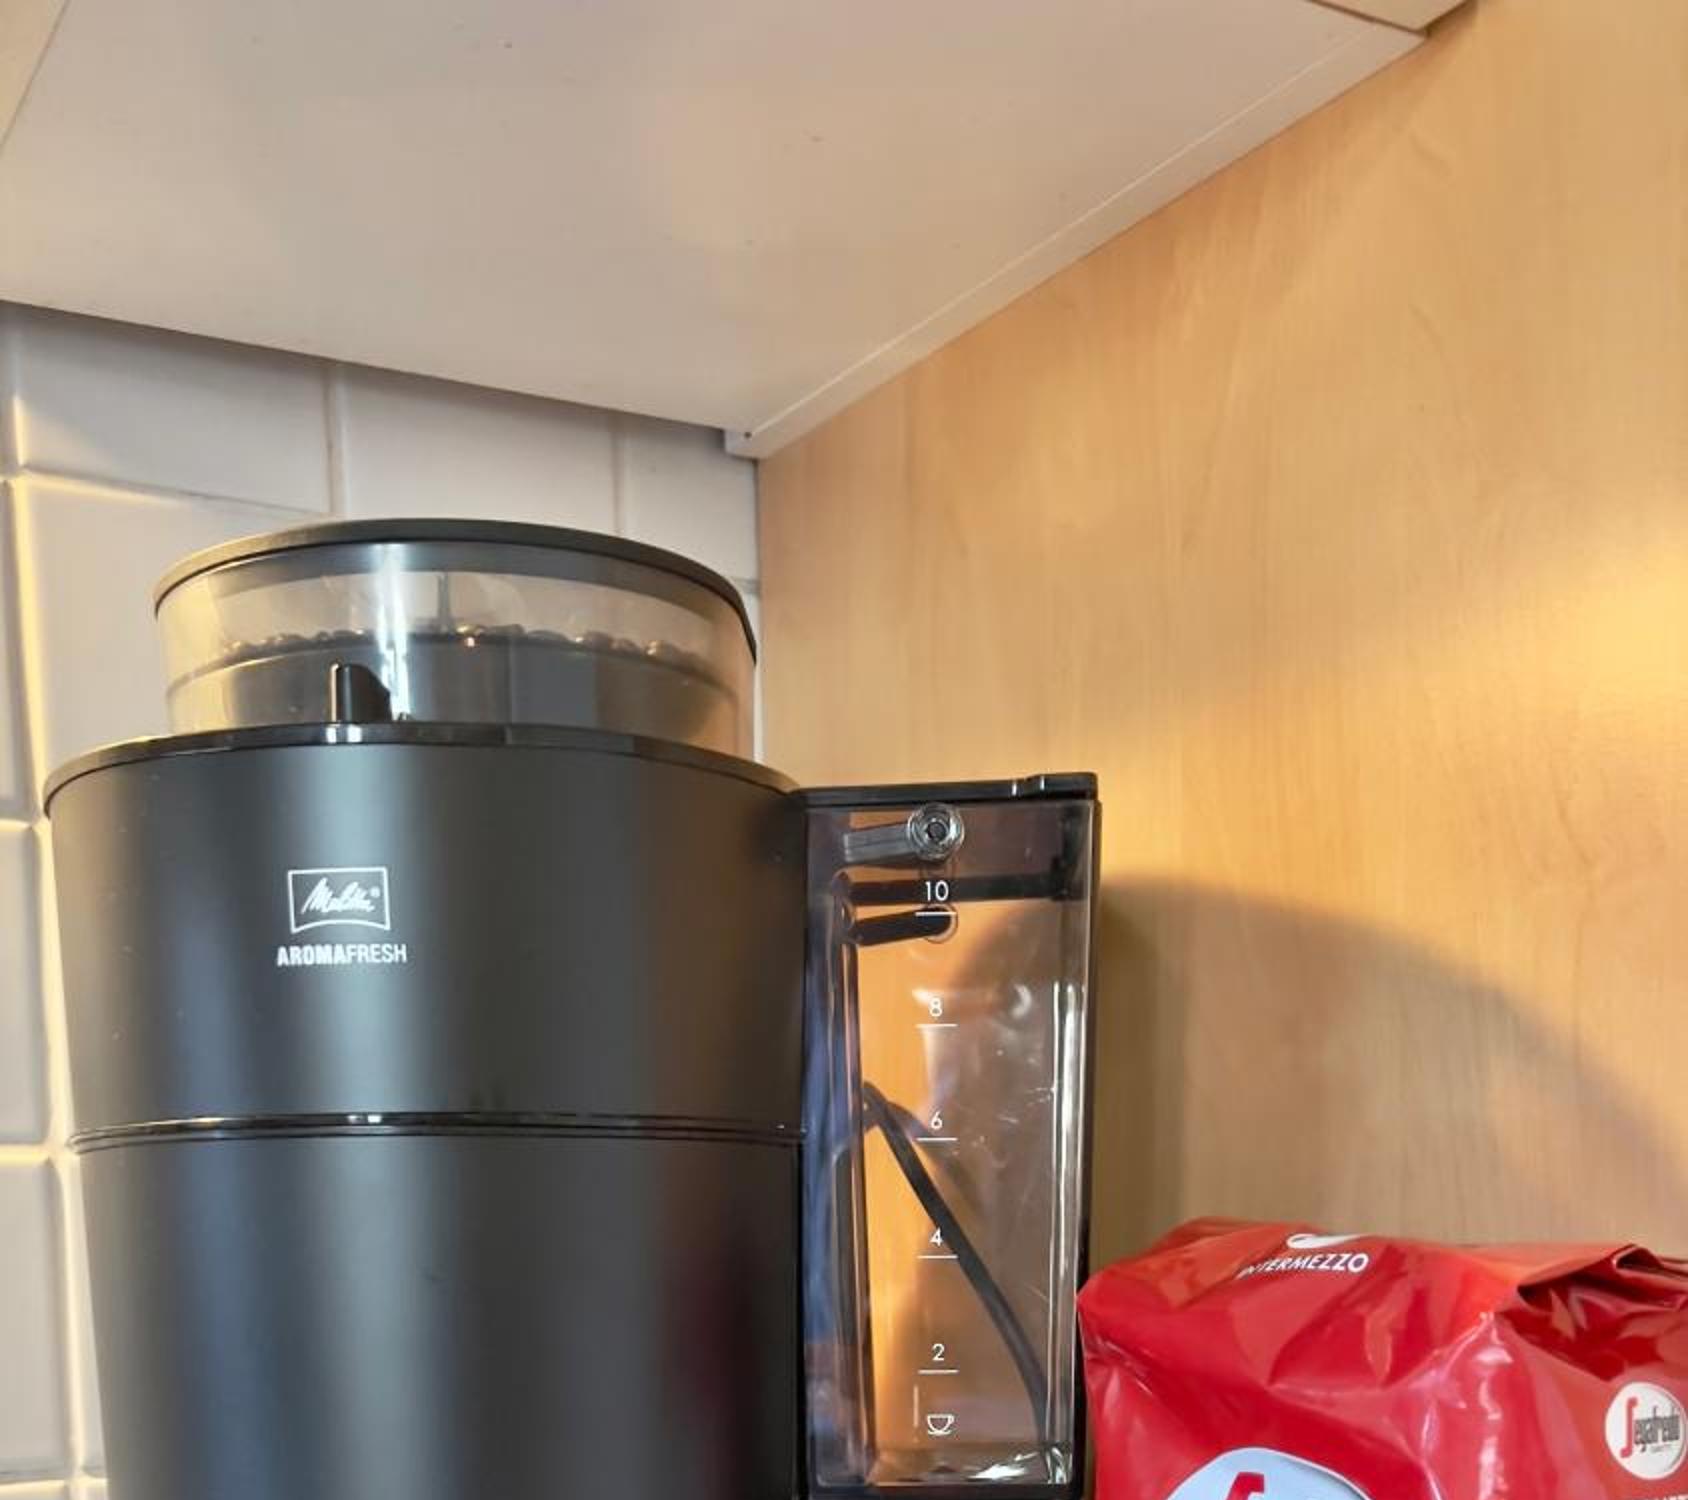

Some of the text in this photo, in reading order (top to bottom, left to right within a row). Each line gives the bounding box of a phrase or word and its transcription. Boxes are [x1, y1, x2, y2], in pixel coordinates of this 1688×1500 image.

[925, 880, 949, 901] 10
[277, 943, 407, 966] AROMAFRESH
[930, 997, 943, 1017] 8
[931, 1111, 943, 1130] 6
[929, 1227, 943, 1247] 4
[931, 1343, 945, 1361] 2
